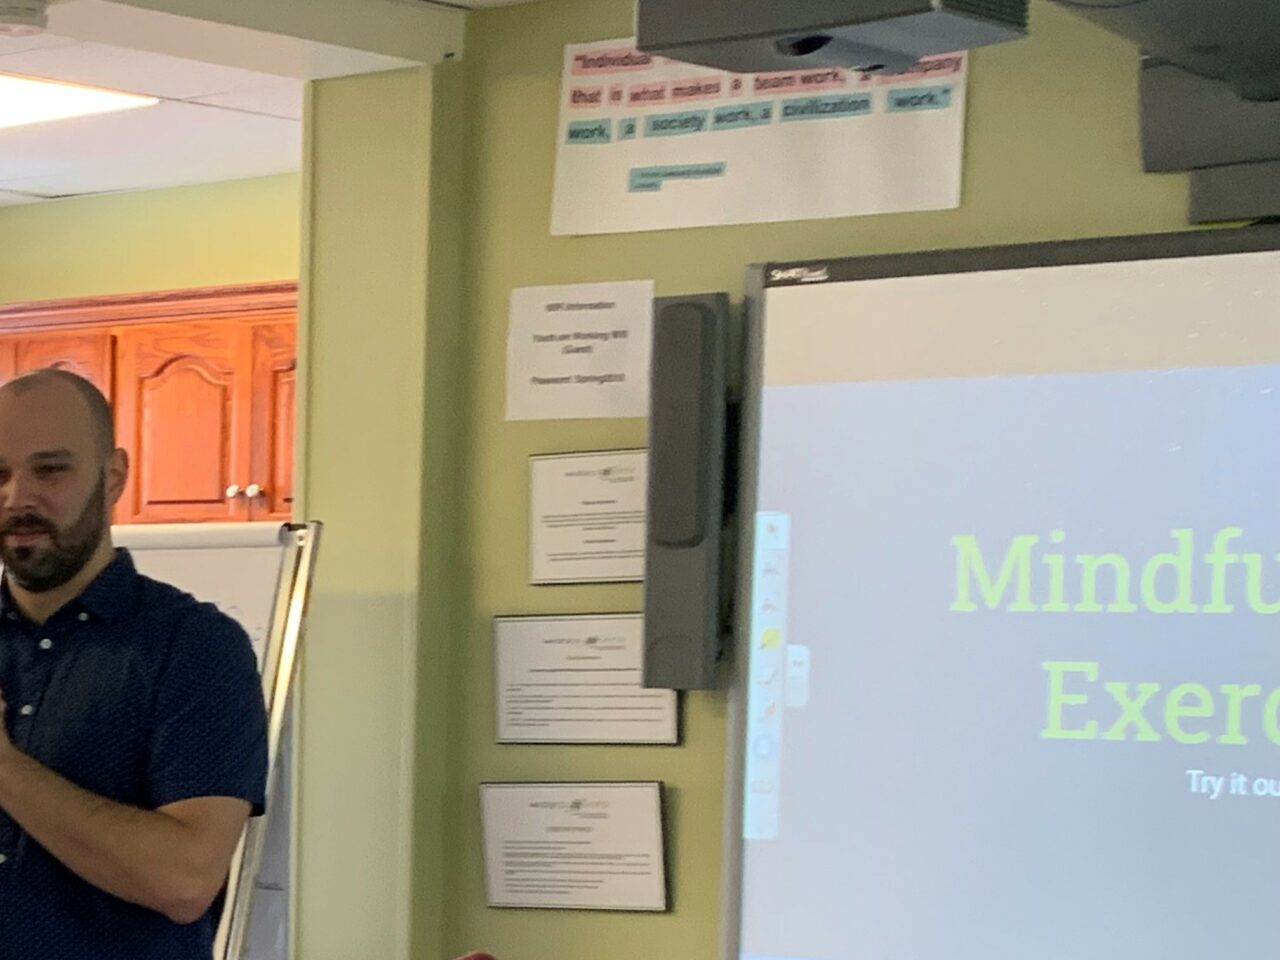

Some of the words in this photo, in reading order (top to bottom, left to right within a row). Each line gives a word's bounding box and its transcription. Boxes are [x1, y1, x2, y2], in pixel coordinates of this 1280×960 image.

[572, 88, 602, 104] that
[630, 87, 665, 101] what
[672, 82, 721, 96] makes
[732, 78, 742, 91] a
[753, 75, 795, 91] team
[625, 123, 635, 134] a
[652, 115, 704, 132] society
[782, 97, 870, 118] civilization
[949, 527, 1280, 614] Mindfu
[1185, 769, 1225, 799] Try
[1230, 771, 1248, 795] it
